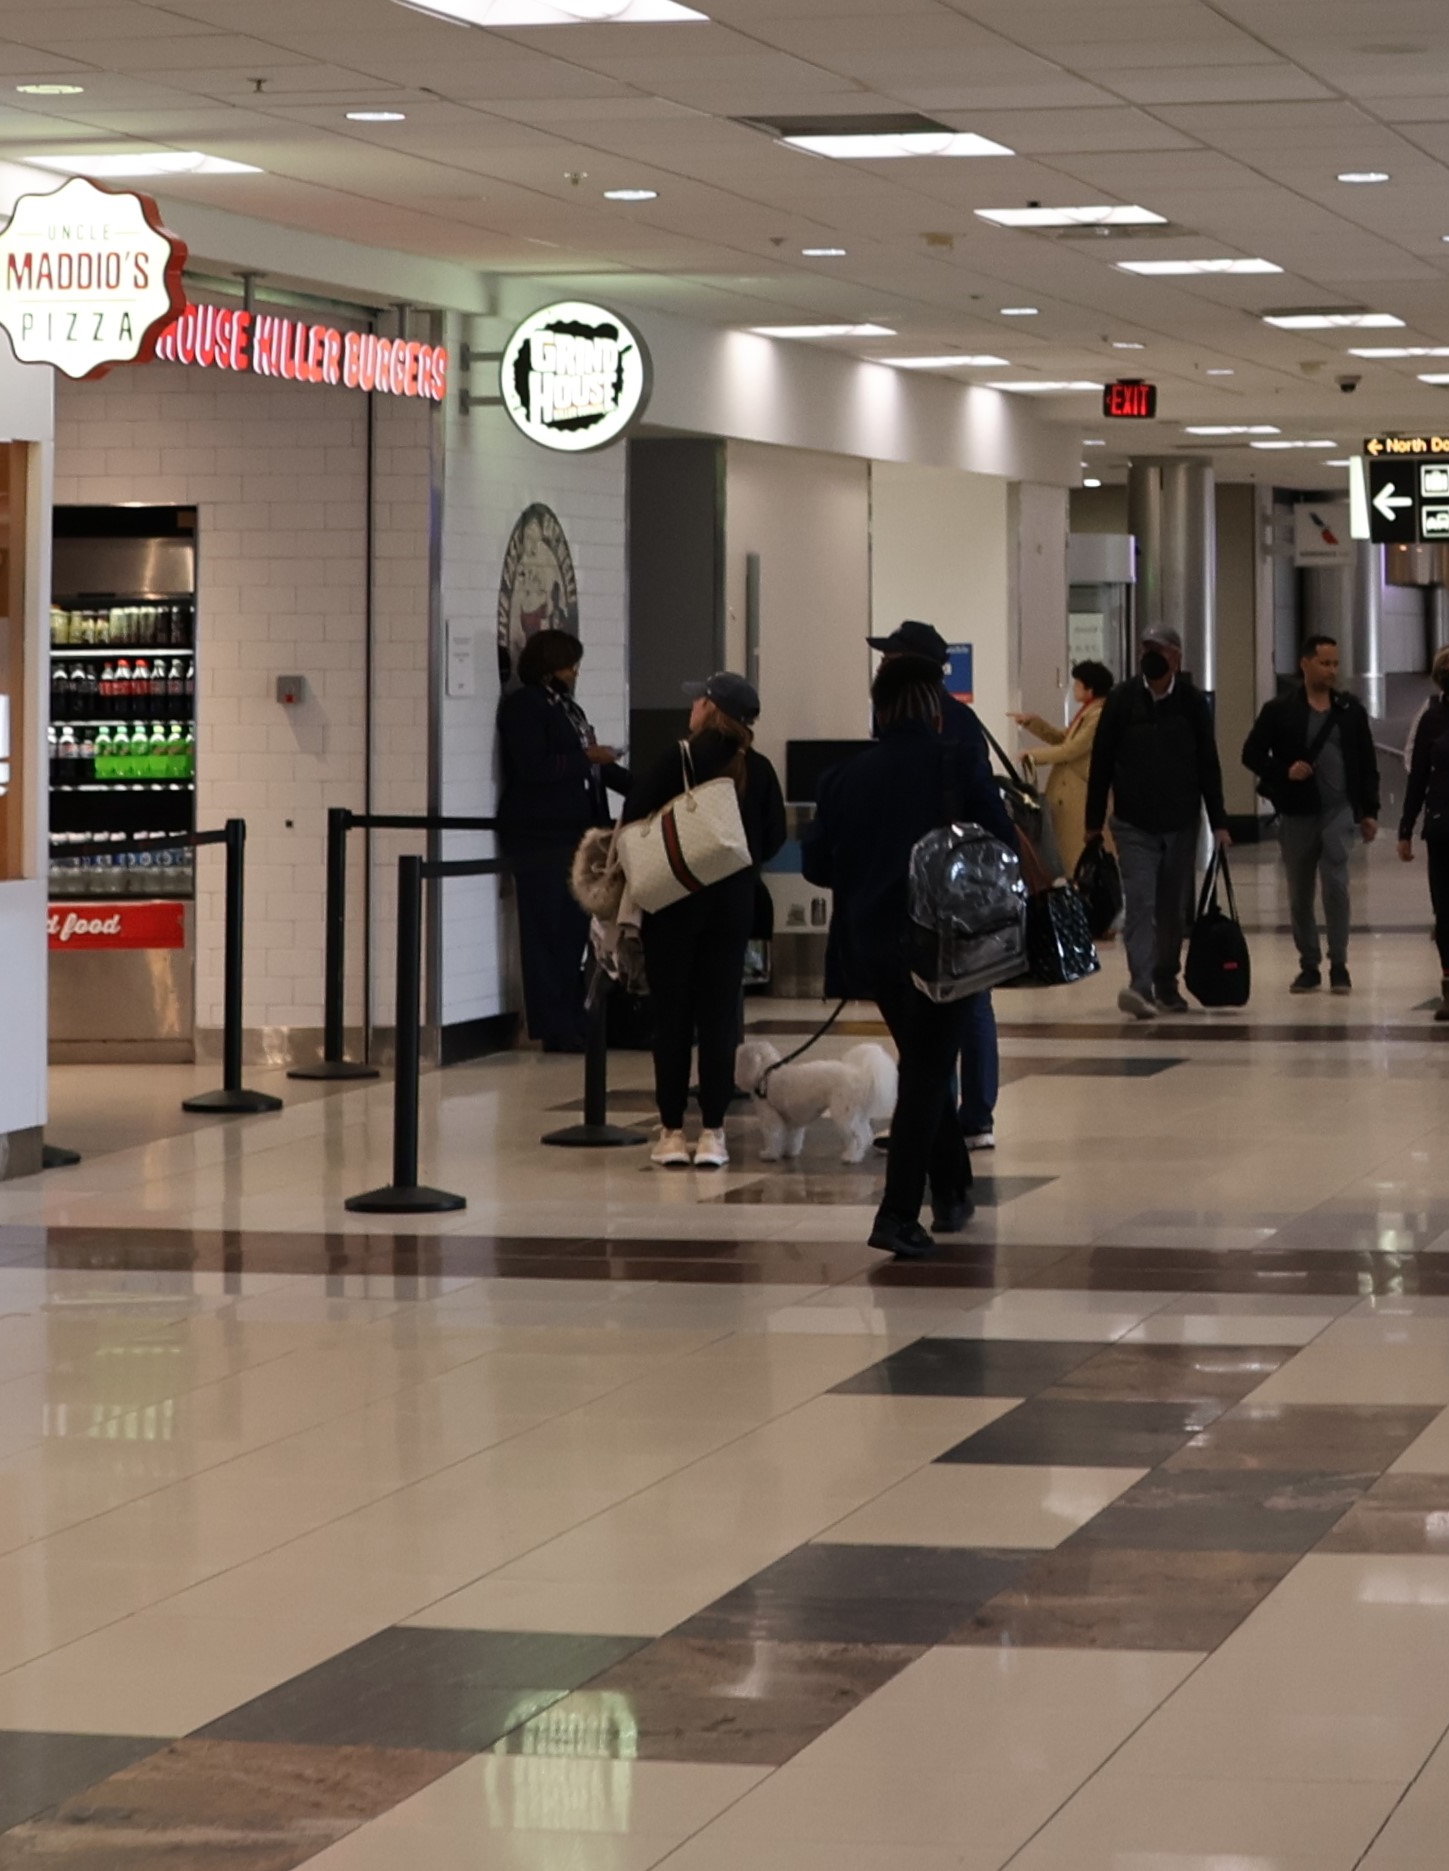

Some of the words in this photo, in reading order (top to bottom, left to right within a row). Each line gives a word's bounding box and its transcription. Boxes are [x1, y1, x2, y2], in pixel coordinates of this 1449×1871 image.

[48, 224, 110, 240] UNCLE
[7, 251, 149, 291] MADDIO'S
[22, 312, 132, 341] PIZZA
[253, 314, 342, 386] KILLER
[343, 331, 448, 401] BURGERS
[529, 329, 619, 376] GRIND
[528, 371, 618, 424] HOUSE
[1111, 385, 1148, 415] EXIT
[1386, 437, 1427, 453] North
[60, 913, 121, 941] food
